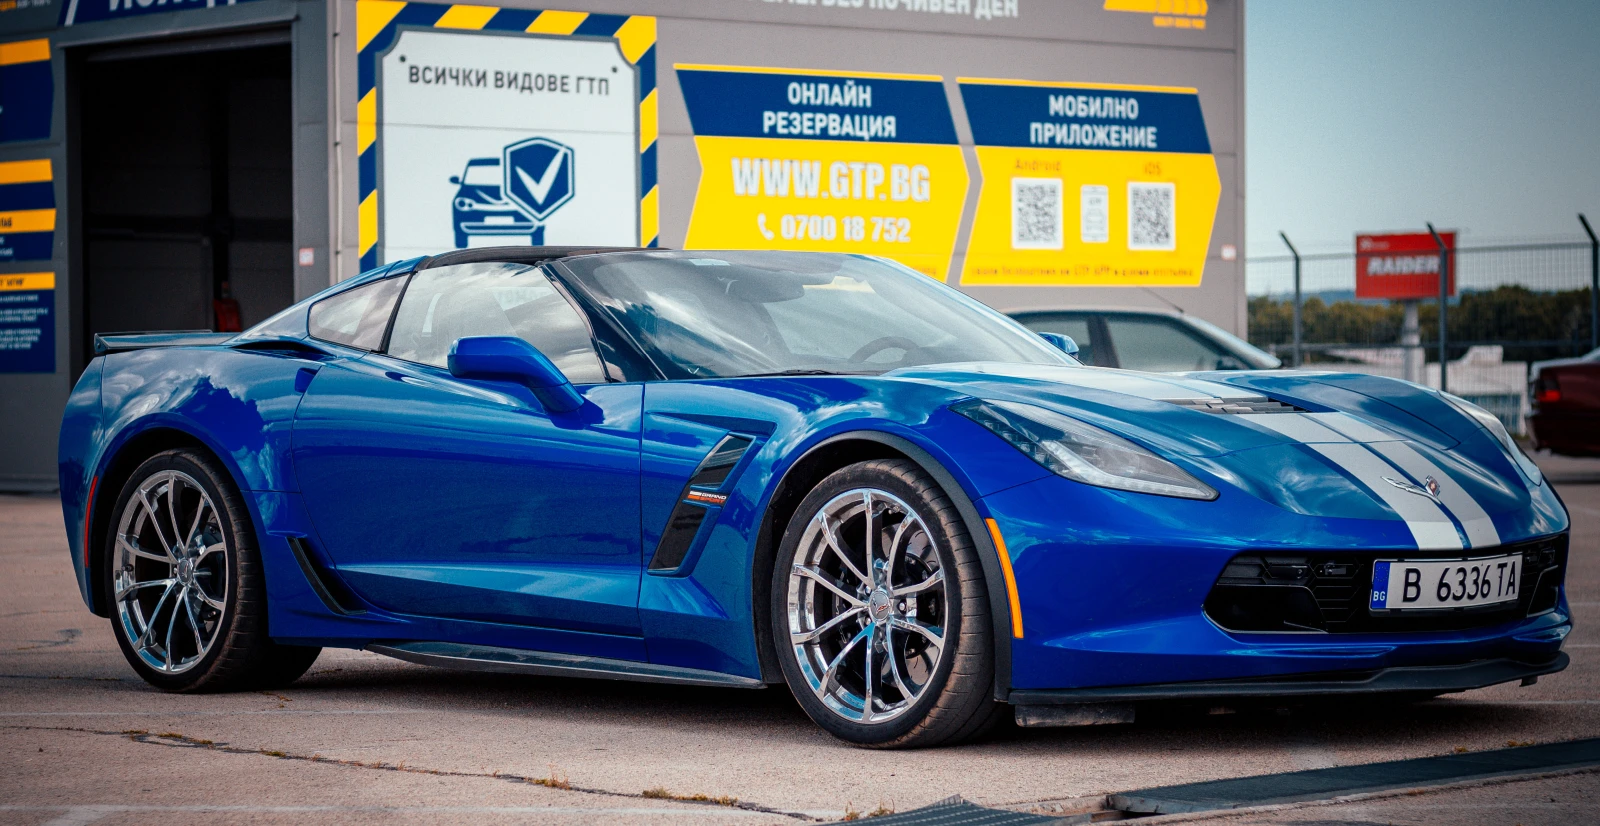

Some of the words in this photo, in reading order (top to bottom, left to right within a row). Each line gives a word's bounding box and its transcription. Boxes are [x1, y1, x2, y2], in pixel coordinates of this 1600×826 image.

[409, 64, 487, 88] ВСИЧКИ
[494, 70, 570, 94] ВИДОВЕ
[576, 76, 610, 95] ГТП
[787, 80, 872, 107] ОНЛАЙН
[1048, 94, 1139, 120] МОБИЛНО
[763, 111, 896, 140] РЕЗЕРВАЦИЯ
[1030, 122, 1158, 148] ПРИЛОЖЕНИЕ
[731, 157, 931, 202] WWW.GTP.BG
[780, 214, 837, 241] 0700
[842, 215, 865, 242] 18
[871, 217, 911, 243] 752
[1367, 255, 1440, 276] RAIDER
[1402, 567, 1422, 602] B
[1436, 564, 1491, 602] 6336
[1497, 560, 1516, 597] TA
[1373, 590, 1386, 602] BG
